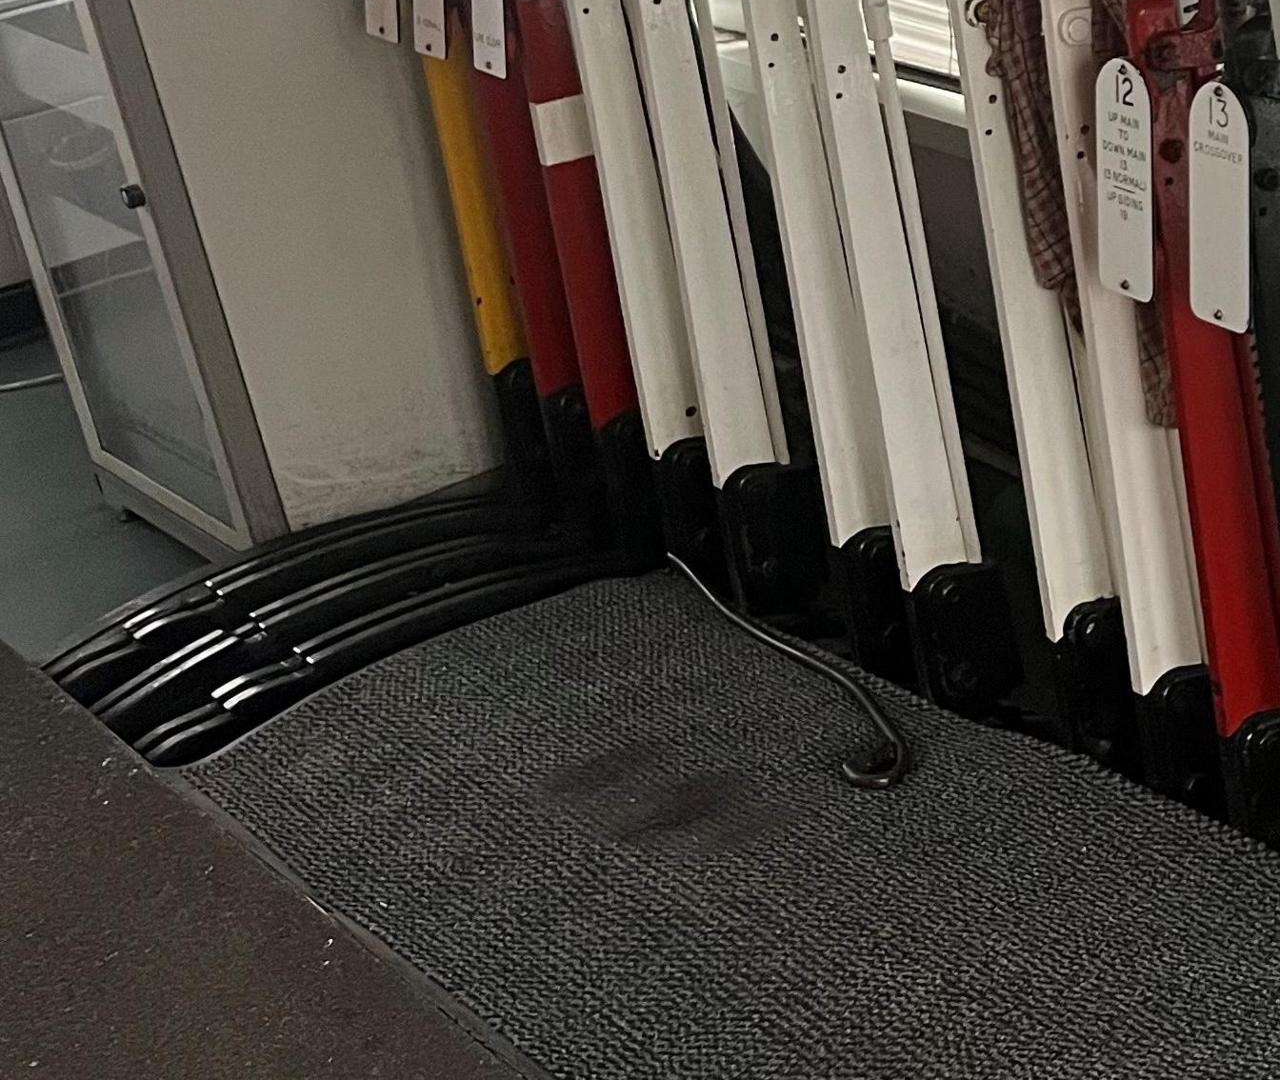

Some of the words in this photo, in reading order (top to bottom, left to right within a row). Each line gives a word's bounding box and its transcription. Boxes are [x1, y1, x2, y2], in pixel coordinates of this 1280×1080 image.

[1115, 74, 1134, 107] 12
[1108, 112, 1118, 122] UP
[1120, 114, 1140, 130] MAIN
[1209, 96, 1229, 128] 13
[1118, 128, 1129, 141] TO
